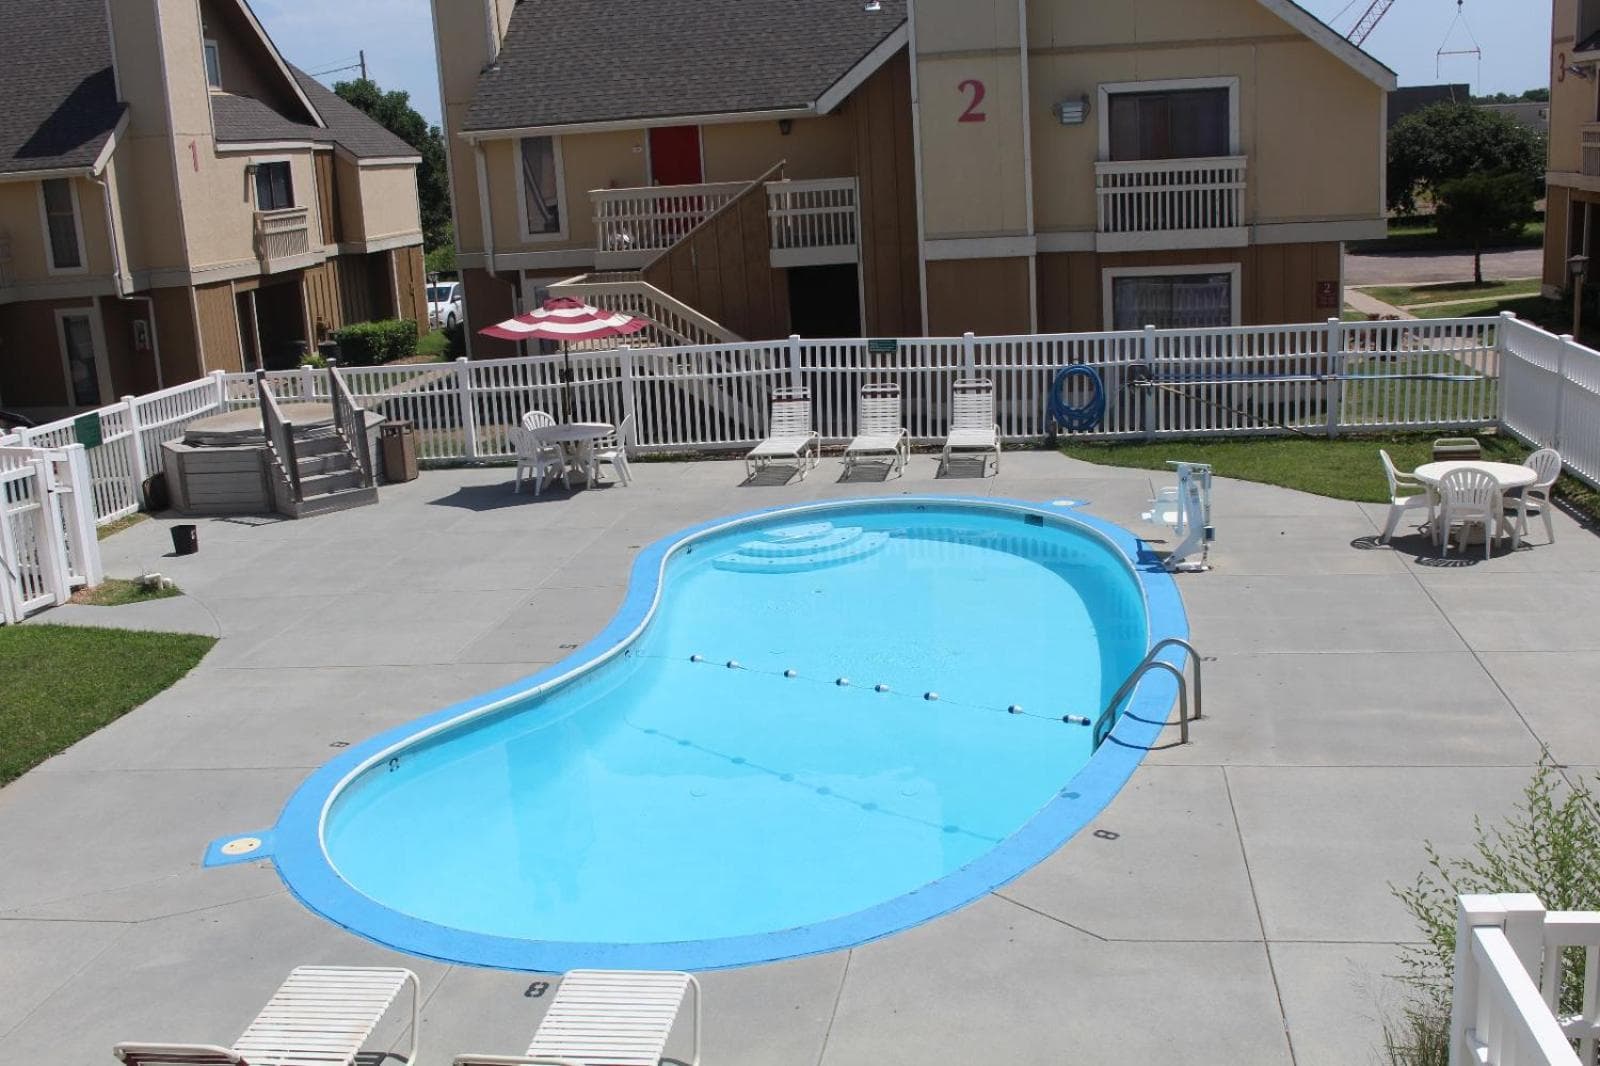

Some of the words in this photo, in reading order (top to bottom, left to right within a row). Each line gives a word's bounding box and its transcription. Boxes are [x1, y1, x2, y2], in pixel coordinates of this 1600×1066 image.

[1558, 52, 1566, 83] 3
[957, 79, 986, 123] 2
[188, 139, 199, 173] 1
[1324, 283, 1331, 293] 2
[1093, 829, 1121, 841] 8
[524, 981, 550, 998] 8
